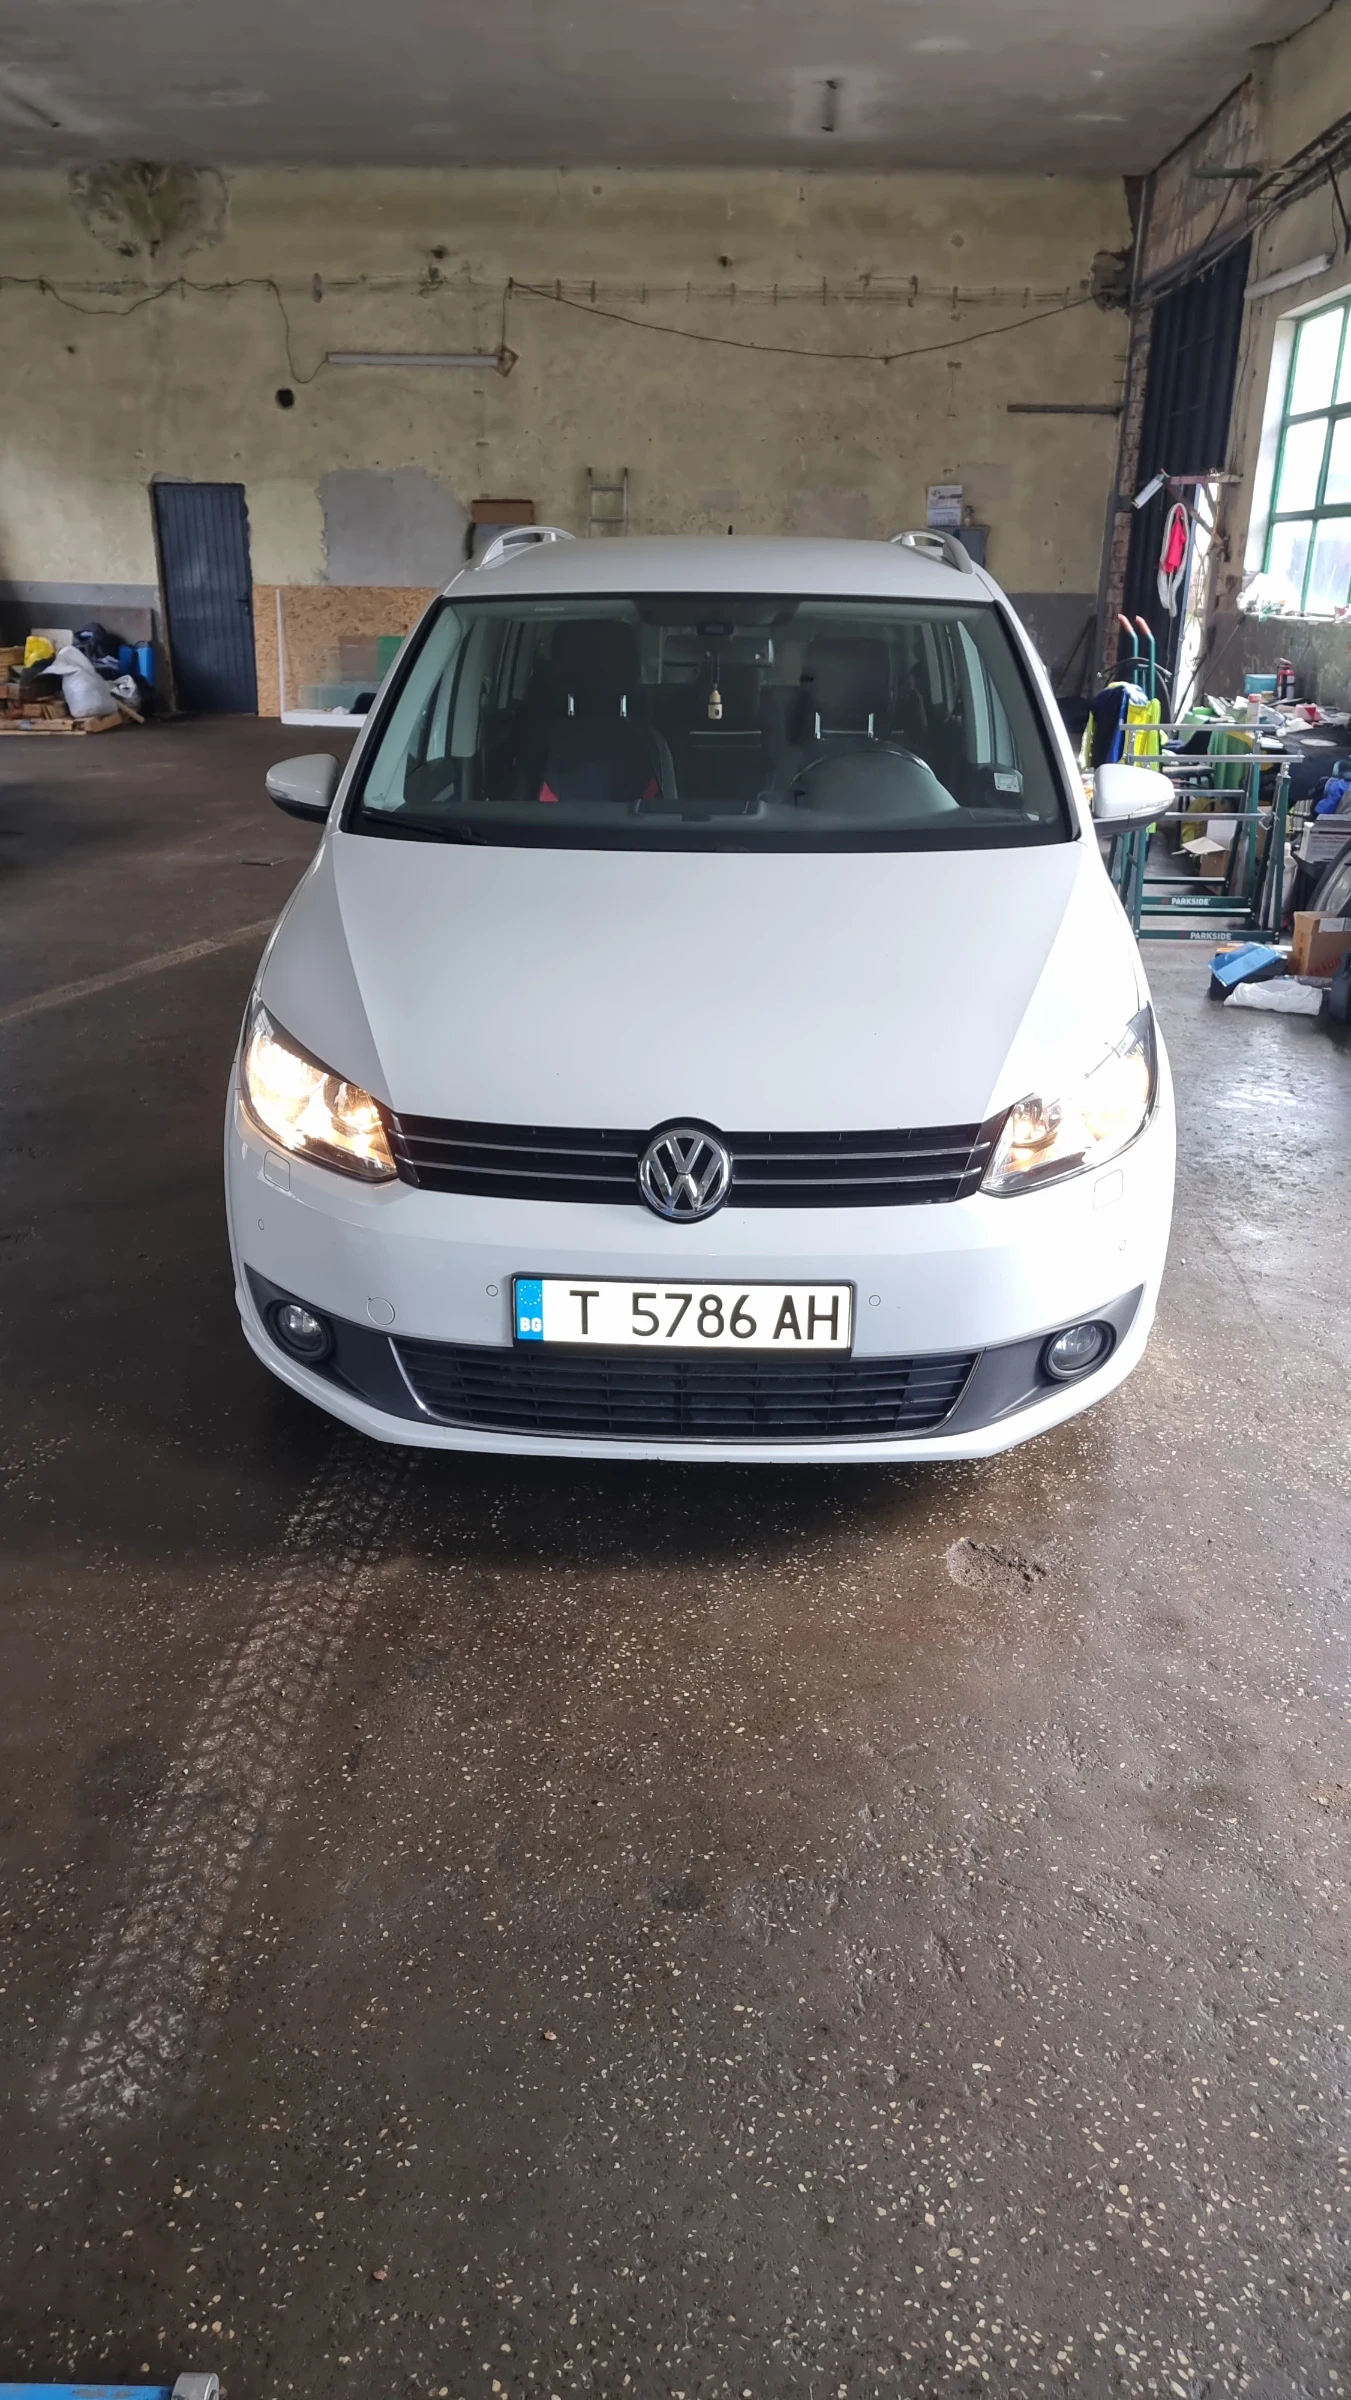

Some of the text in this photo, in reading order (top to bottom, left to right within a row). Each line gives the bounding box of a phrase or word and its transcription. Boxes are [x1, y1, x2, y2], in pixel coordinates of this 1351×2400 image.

[1171, 897, 1210, 906] PARKSIDE
[1190, 932, 1232, 940] PARKSIDE
[569, 1290, 839, 1340] T 5786 AH
[520, 1316, 543, 1333] BG
